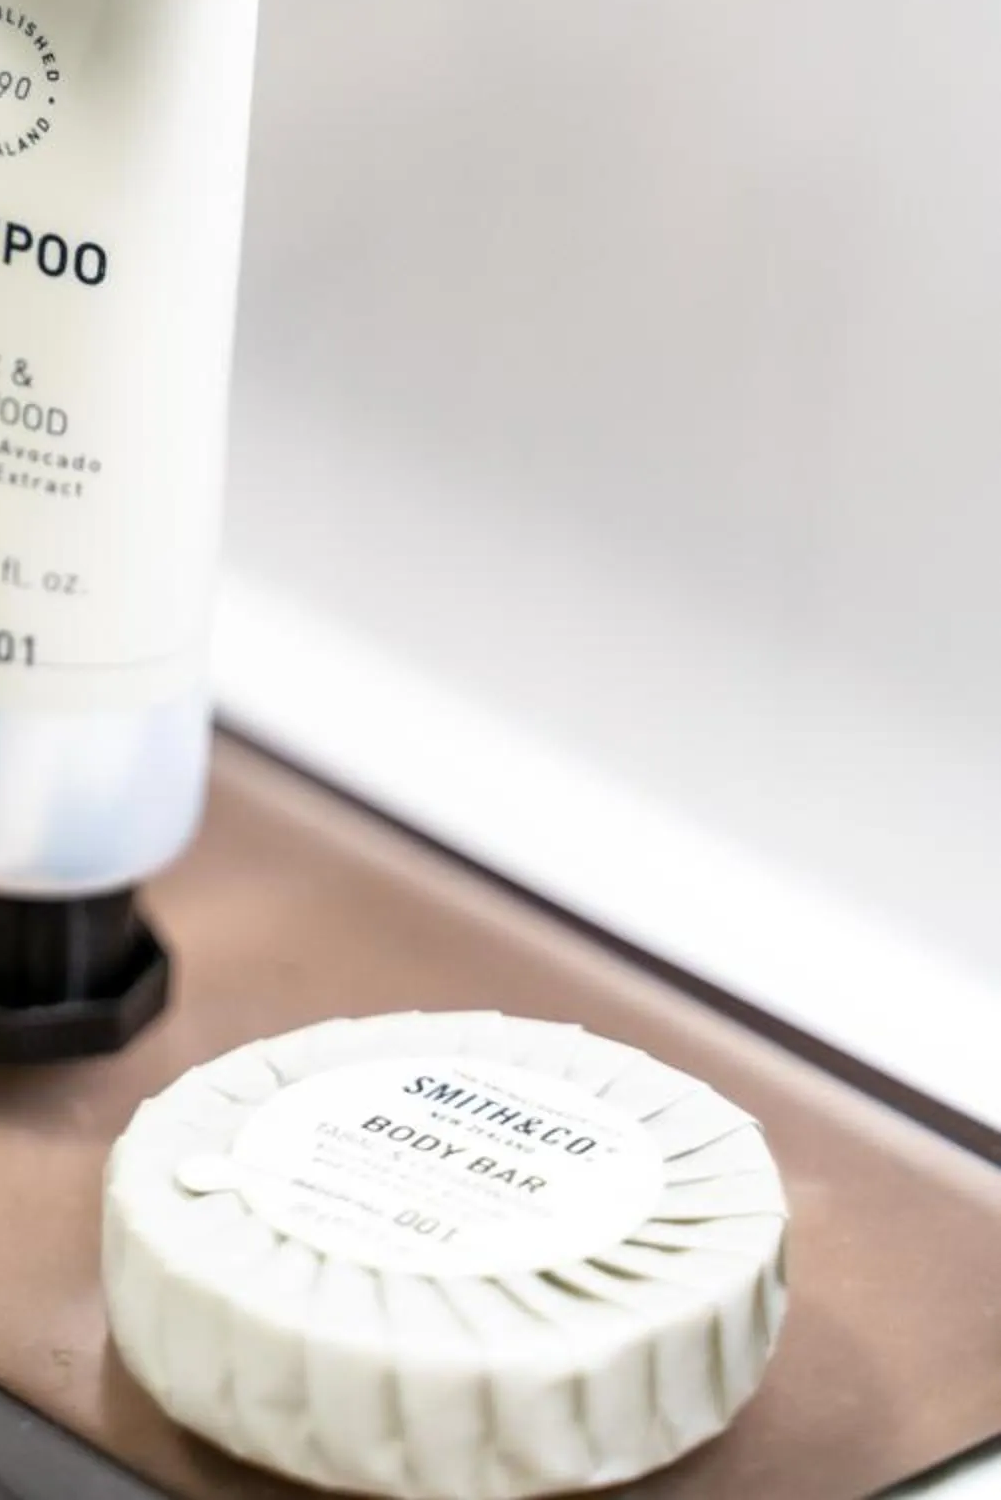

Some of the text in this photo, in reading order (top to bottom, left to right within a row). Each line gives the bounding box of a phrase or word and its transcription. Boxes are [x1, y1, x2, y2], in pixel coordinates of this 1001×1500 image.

[10, 358, 33, 389] &
[360, 1114, 467, 1161] BODY
[465, 1155, 548, 1194] BAR
